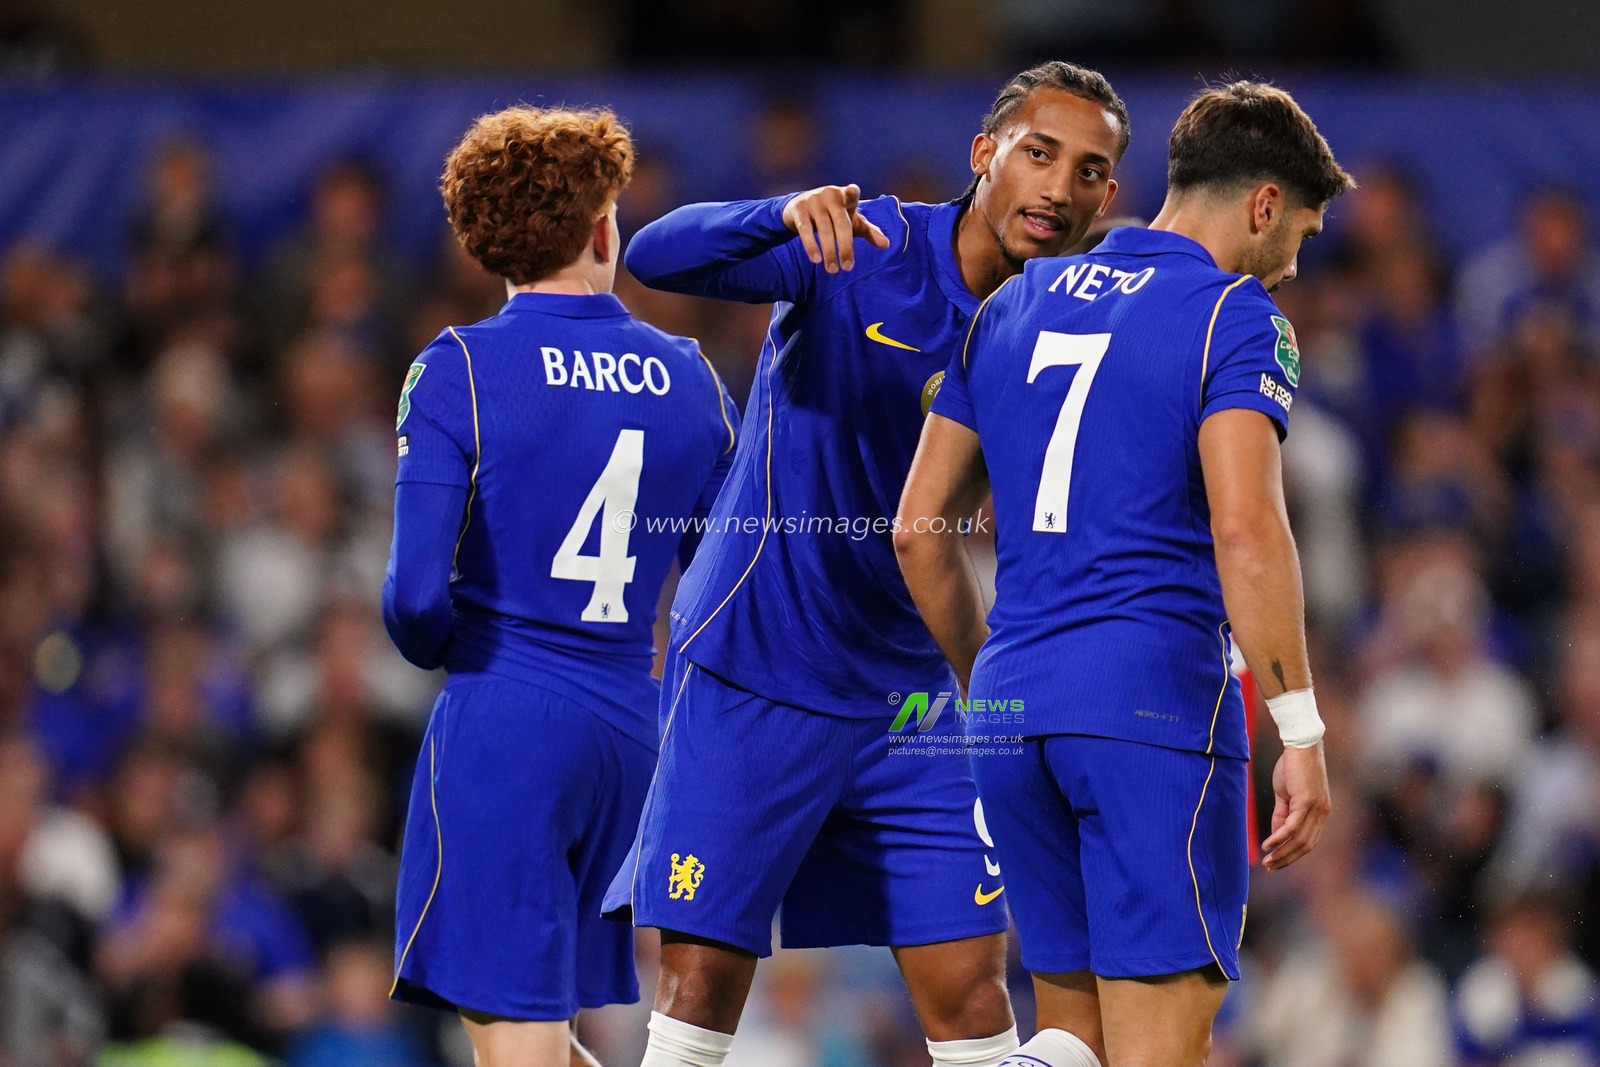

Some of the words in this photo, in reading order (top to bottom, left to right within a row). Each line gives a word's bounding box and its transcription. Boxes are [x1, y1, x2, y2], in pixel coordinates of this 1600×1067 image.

[1048, 263, 1155, 301] NETO
[540, 346, 671, 396] BARCO
[926, 375, 946, 396] WORL
[1261, 372, 1276, 390] No
[1276, 384, 1293, 405] roo
[1026, 330, 1112, 534] 7
[550, 429, 644, 623] 4
